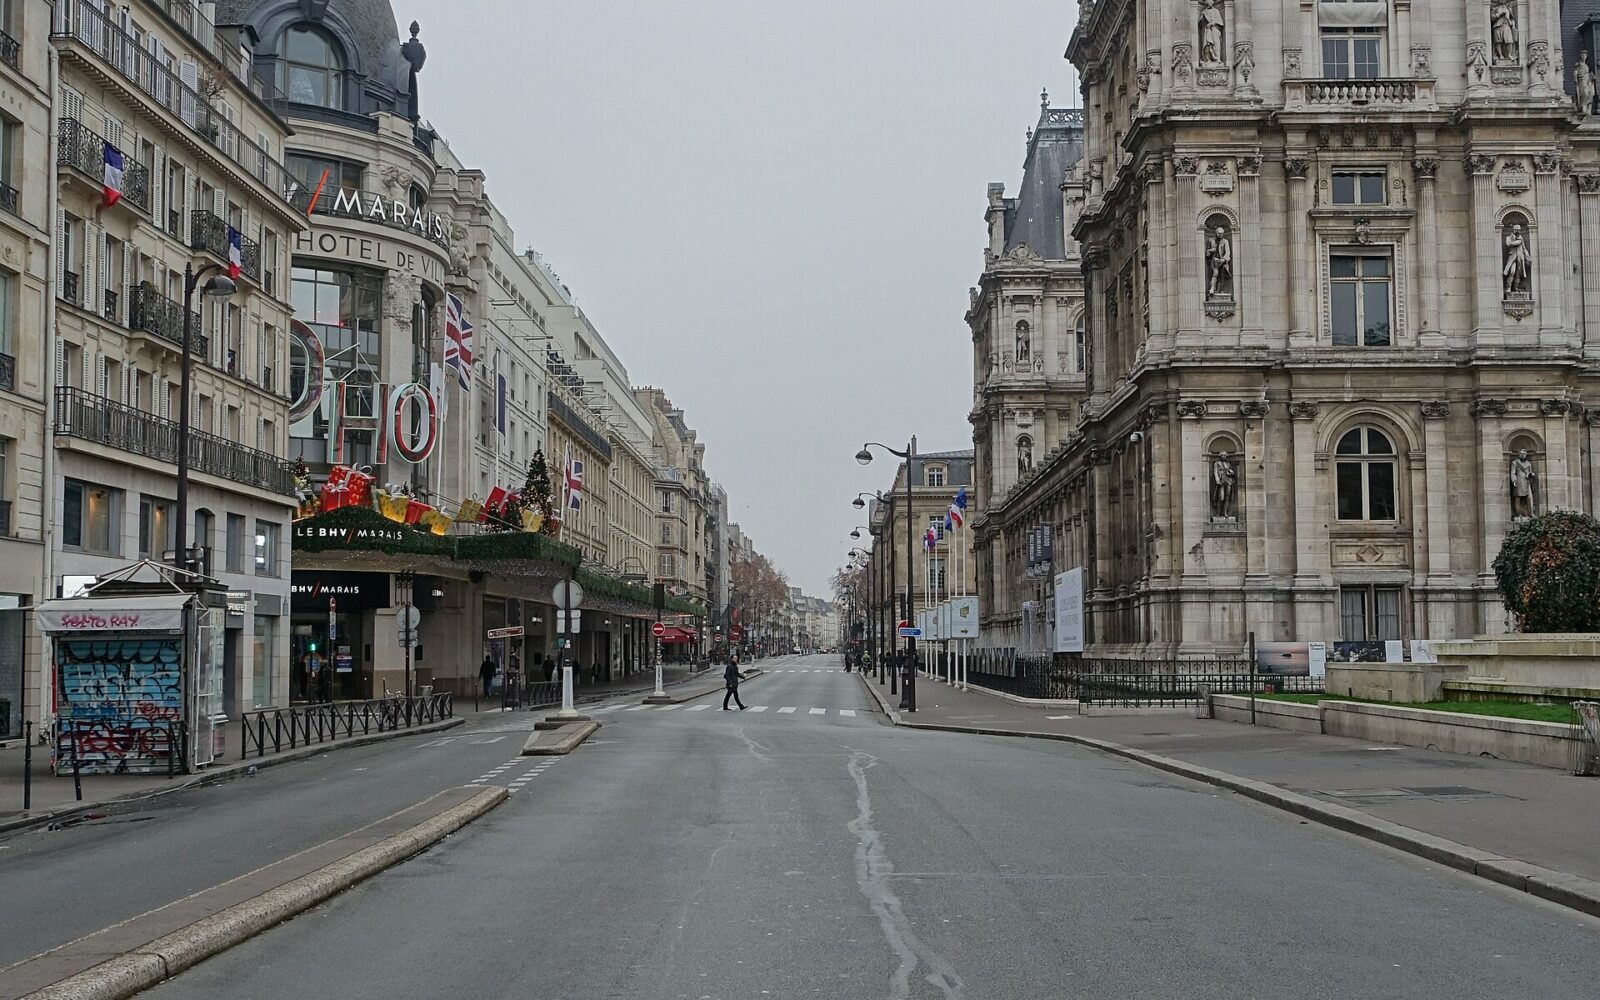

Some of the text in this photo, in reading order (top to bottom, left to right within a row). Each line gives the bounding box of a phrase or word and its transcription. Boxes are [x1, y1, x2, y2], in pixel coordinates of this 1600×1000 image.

[296, 229, 387, 263] HOTEL
[397, 251, 415, 271] DE
[297, 527, 314, 537] LE
